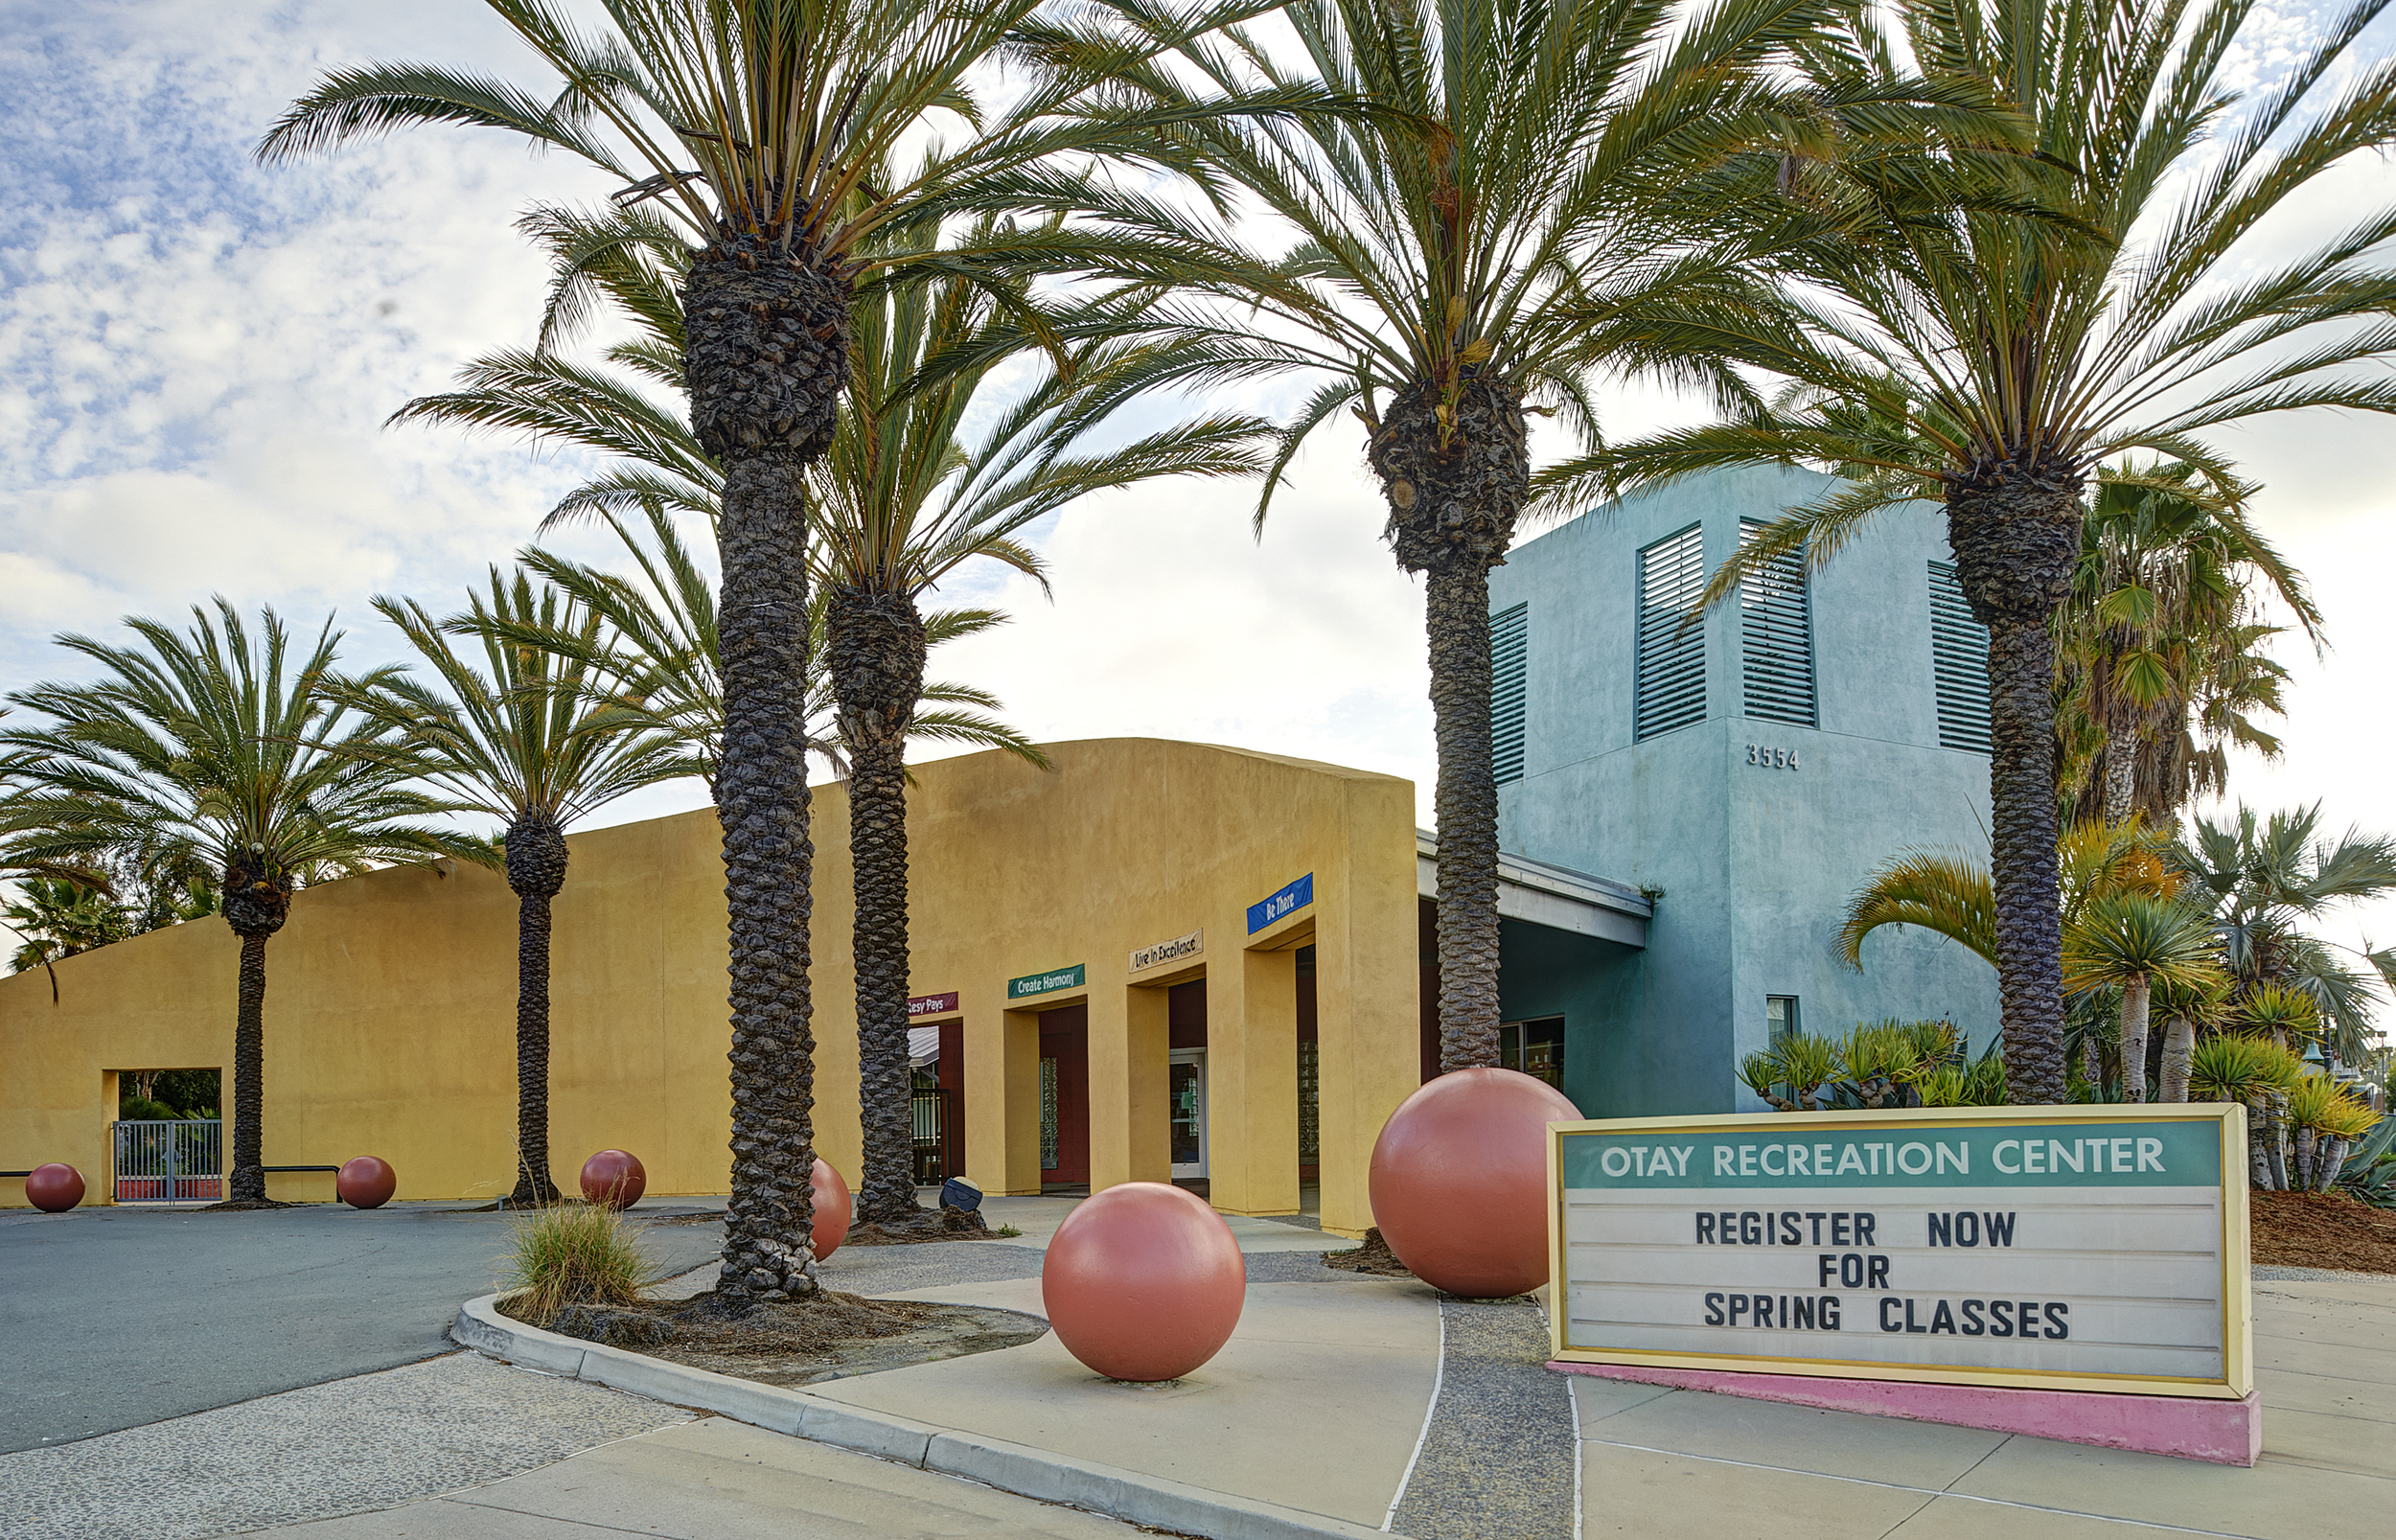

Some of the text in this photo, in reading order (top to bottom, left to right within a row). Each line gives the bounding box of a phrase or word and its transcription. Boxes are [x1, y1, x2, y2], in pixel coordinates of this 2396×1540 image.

[1748, 742, 1801, 770] 3554
[1266, 892, 1295, 921] Be There
[1135, 938, 1196, 968] Live In Excellence
[1018, 973, 1074, 994] Create Harmony
[926, 999, 944, 1013] Pays
[1601, 1138, 2167, 1178] OTAY RECREATION CENTER
[1695, 1211, 2016, 1248] REGISTER NOW
[1818, 1253, 1890, 1290] FOR
[1704, 1293, 2069, 1340] SPRING CLASSES
